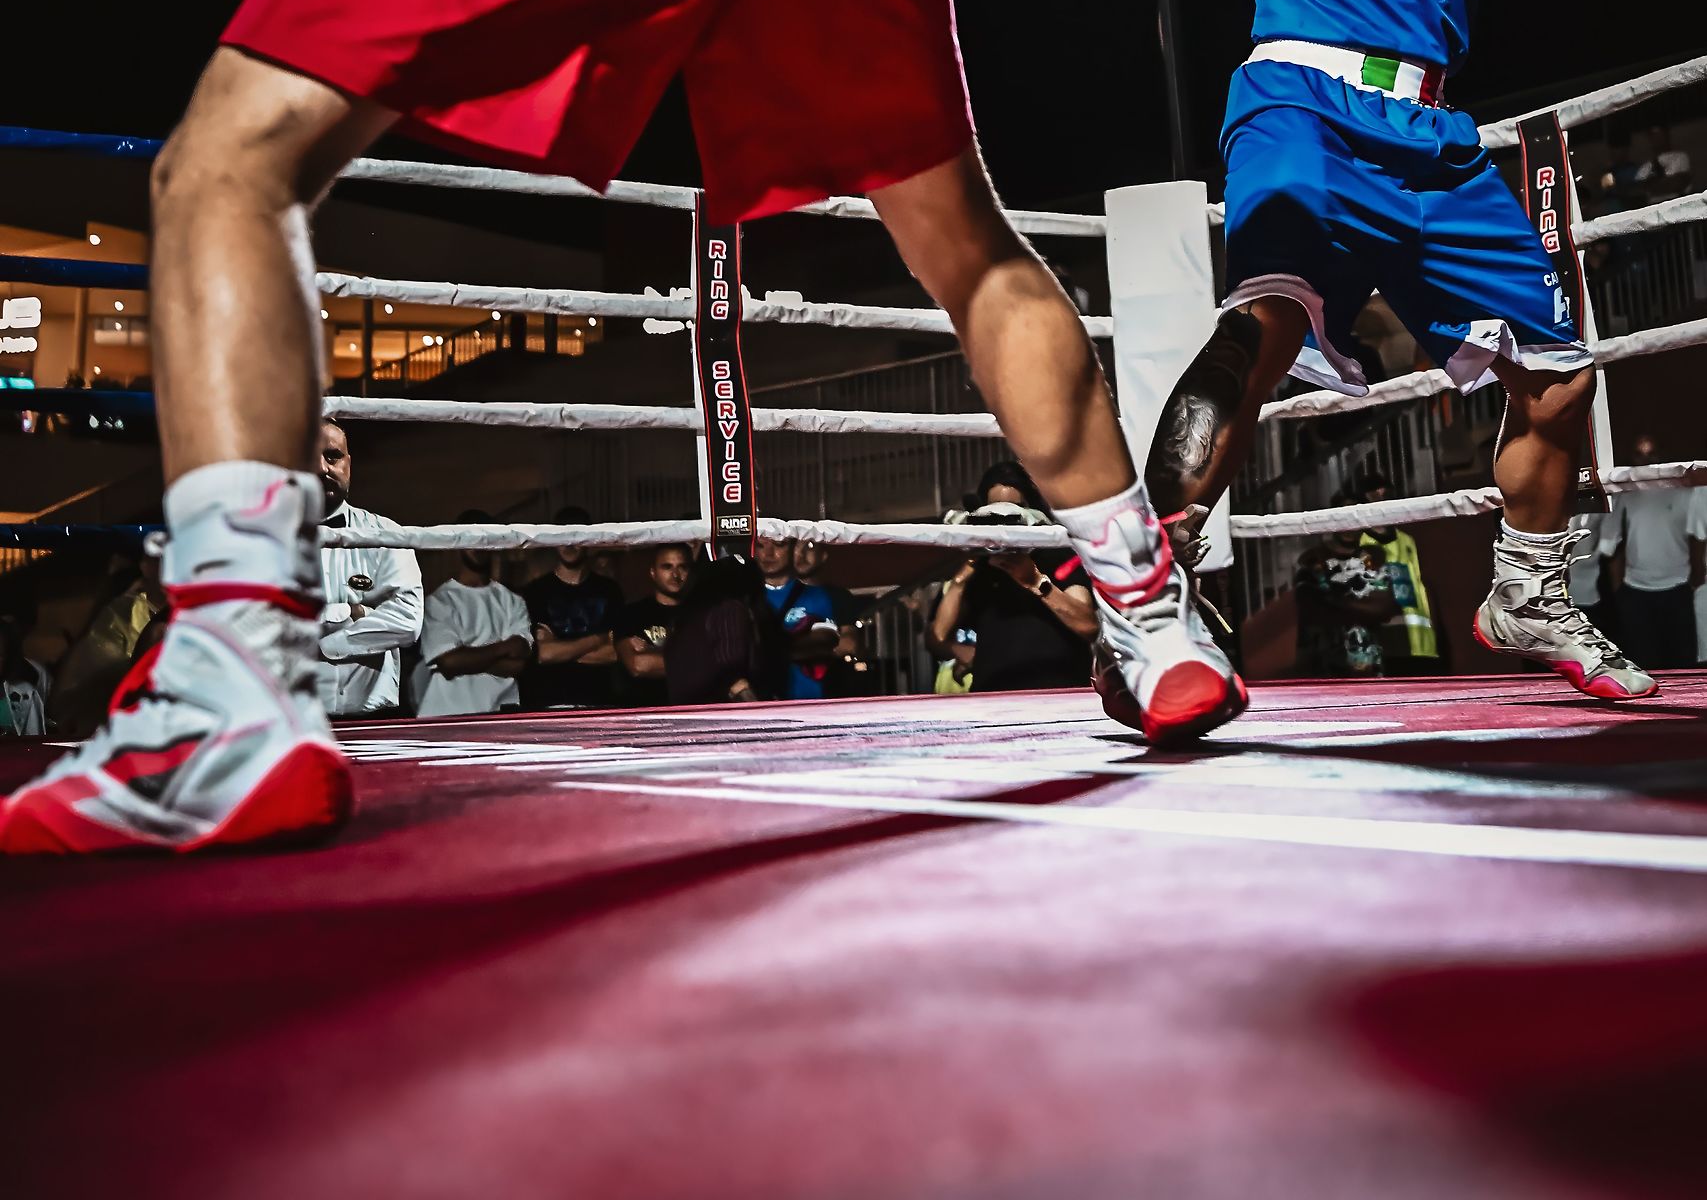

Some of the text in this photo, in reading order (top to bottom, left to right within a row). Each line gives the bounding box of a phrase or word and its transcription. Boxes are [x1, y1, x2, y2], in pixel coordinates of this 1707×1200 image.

[1537, 166, 1560, 254] RING
[708, 239, 729, 320] RING
[712, 360, 742, 503] SERVICE
